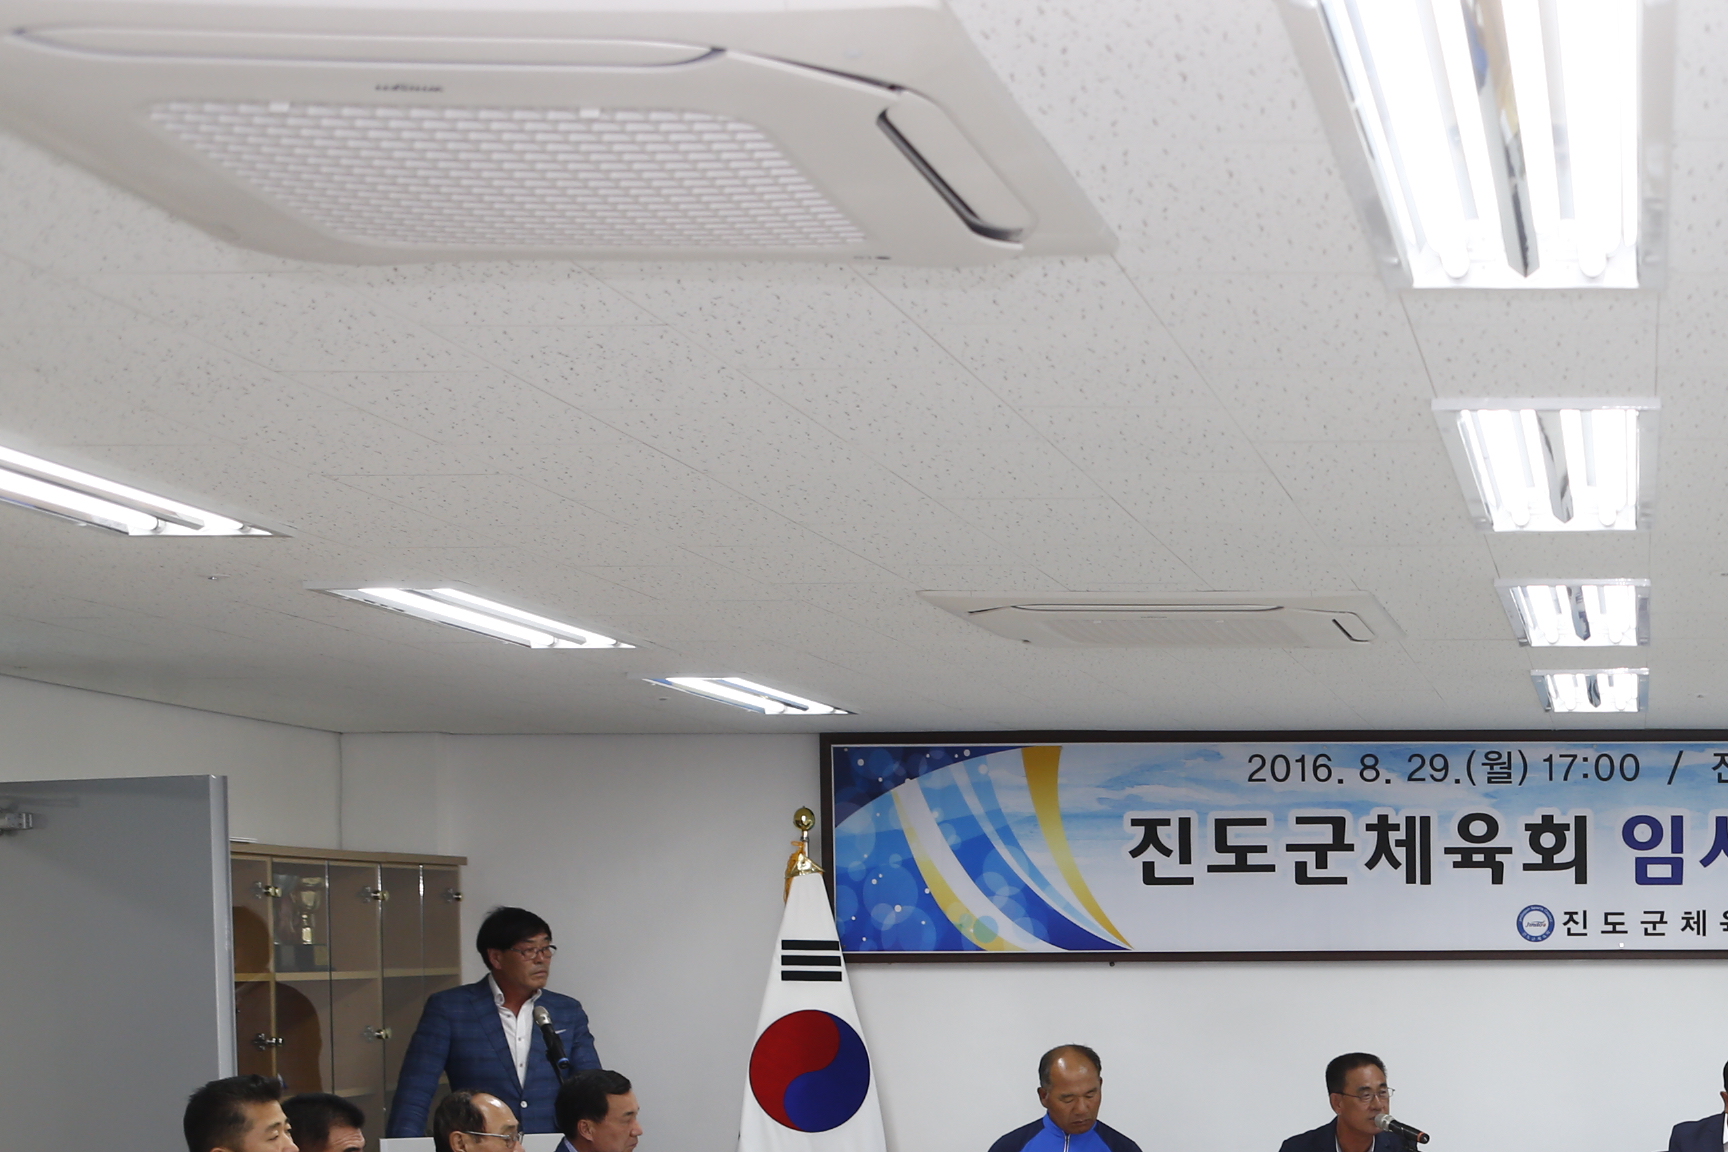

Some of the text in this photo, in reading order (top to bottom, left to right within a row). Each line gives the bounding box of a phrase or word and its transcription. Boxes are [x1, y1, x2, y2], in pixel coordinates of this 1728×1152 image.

[1247, 753, 1344, 784] 2016.
[1359, 753, 1391, 784] 8.
[1542, 753, 1641, 783] 17:00
[1128, 812, 1588, 886] 진도군체육회
